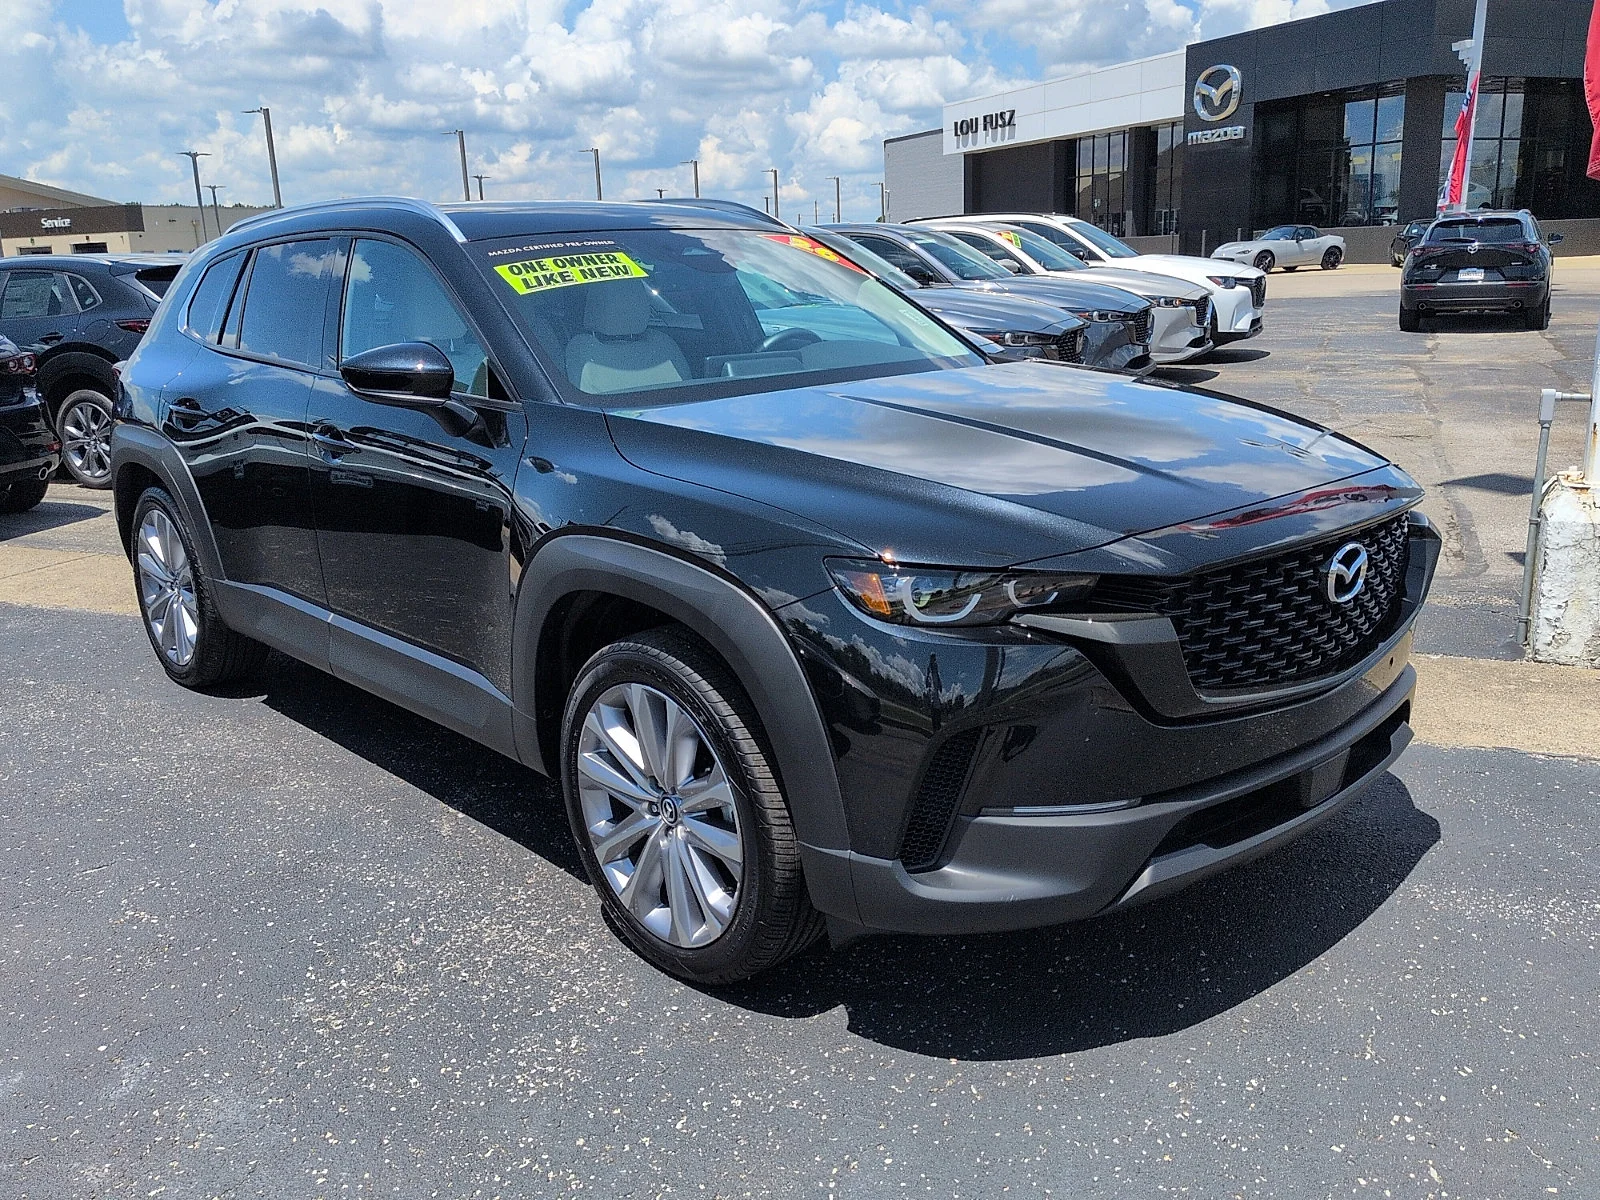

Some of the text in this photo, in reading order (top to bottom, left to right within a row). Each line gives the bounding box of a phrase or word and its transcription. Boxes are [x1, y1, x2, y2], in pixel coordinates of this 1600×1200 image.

[953, 109, 1016, 137] LOU FUSZ
[1187, 125, 1246, 146] mazda
[41, 216, 71, 229] Service
[488, 239, 616, 257] MAZDA CERTIFIED PRE-OWNED
[507, 253, 622, 276] ONE OWNER
[521, 264, 632, 290] LIKE NEW
